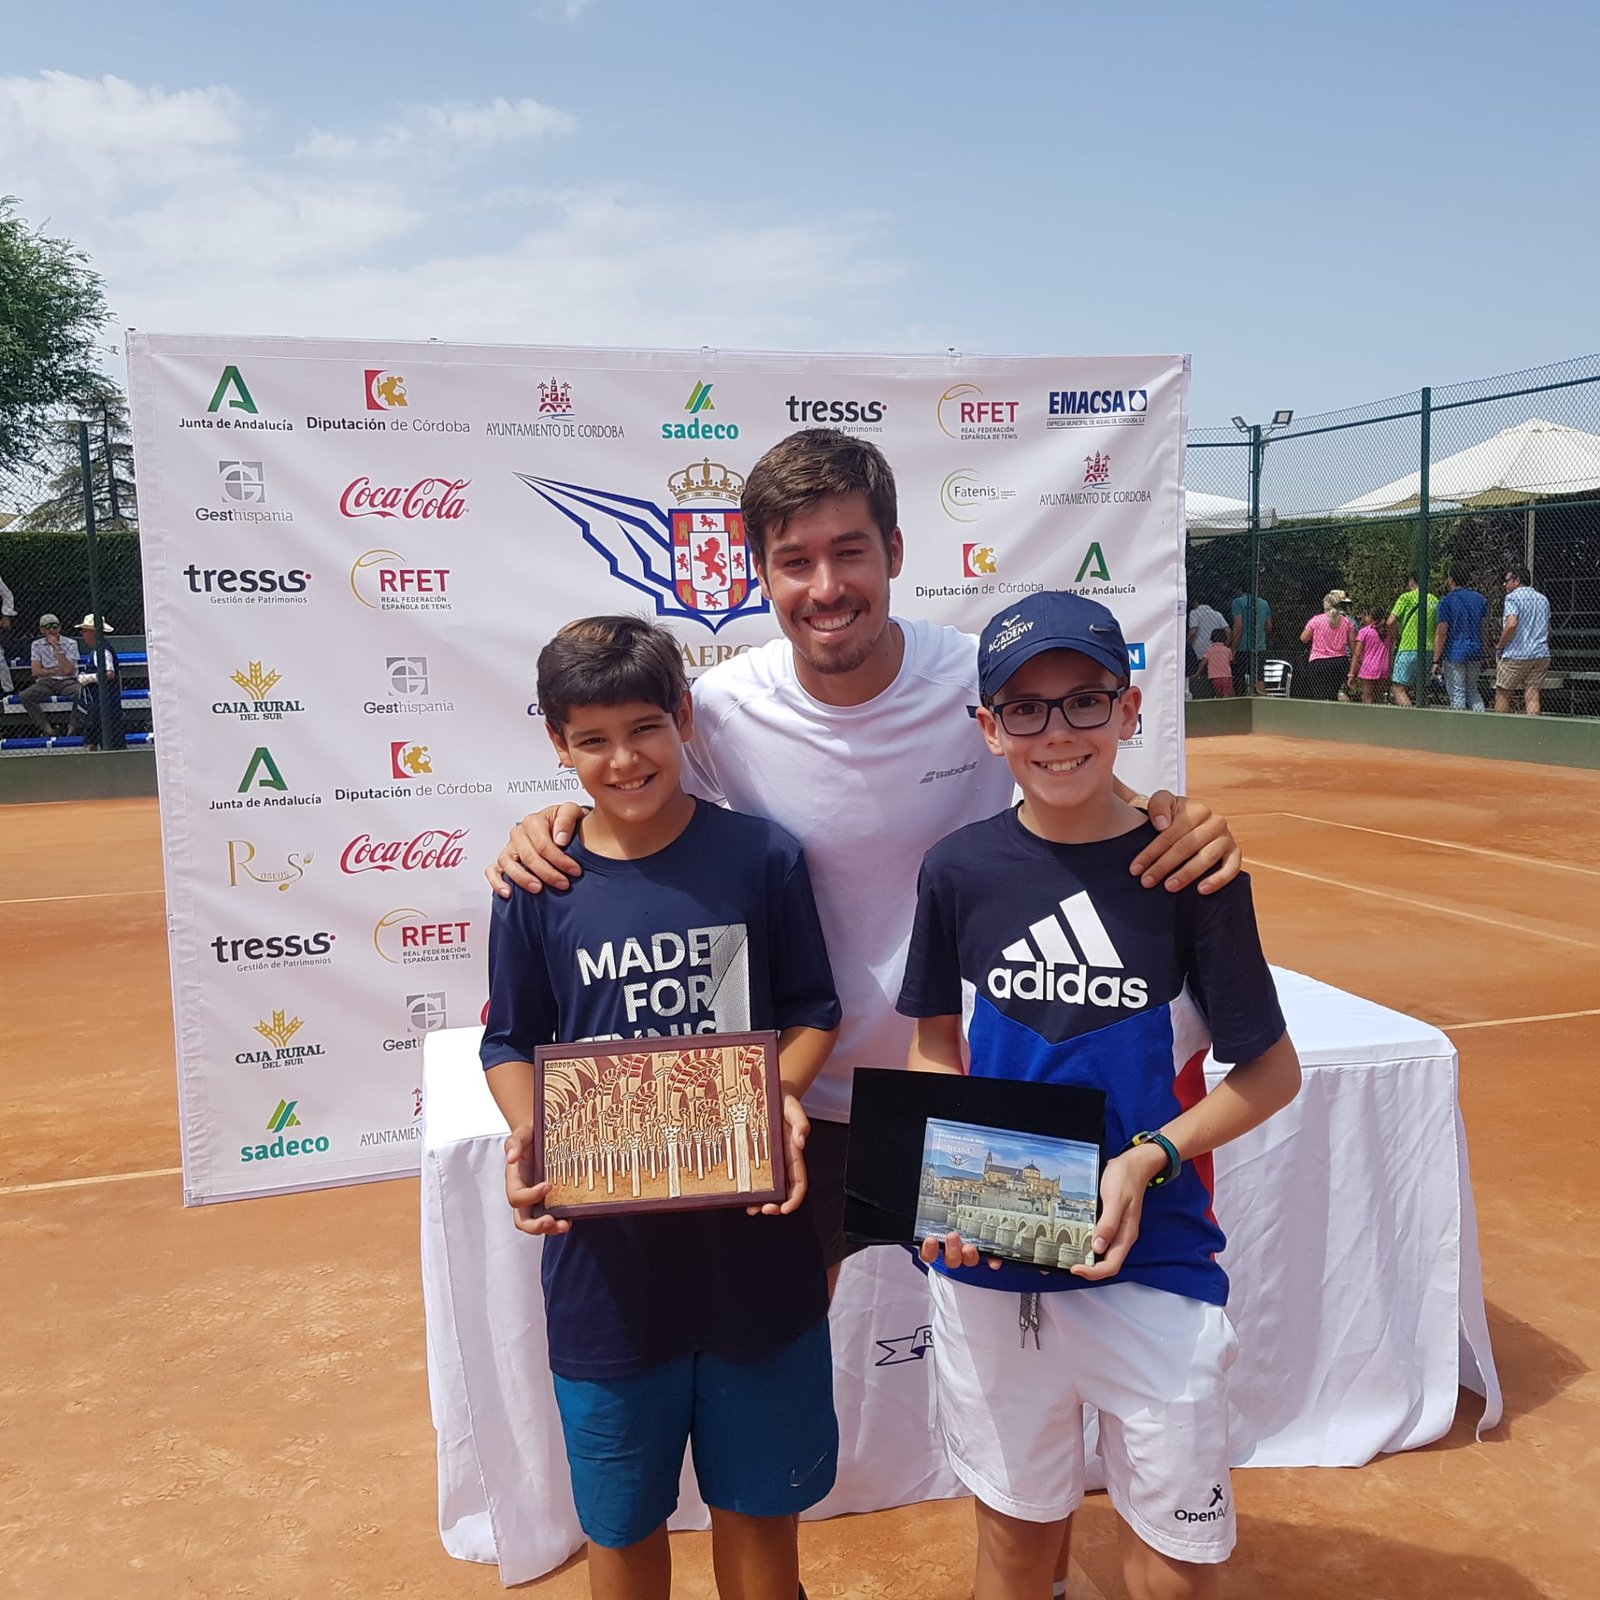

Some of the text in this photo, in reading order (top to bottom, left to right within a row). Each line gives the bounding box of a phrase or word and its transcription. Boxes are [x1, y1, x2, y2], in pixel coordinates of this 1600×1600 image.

[785, 395, 888, 423] tressis
[1049, 390, 1126, 414] EMACSA
[961, 402, 1019, 423] RFET
[178, 418, 294, 431] Junta de Andalucía
[306, 416, 471, 433] Diputación de Córdoba
[486, 422, 625, 439] AYUNTAMIENTO DE CORDOBA
[661, 418, 739, 440] sadeco
[339, 477, 472, 520] Coca-Cola
[954, 485, 996, 498] Fatenis
[1039, 490, 1152, 506] AYUNTAMIENTO DE CORDOBA
[195, 507, 294, 524] Gesthispania
[183, 564, 312, 593] tressis
[379, 569, 450, 592] RFET
[915, 583, 979, 597] Diputación
[981, 583, 995, 595] de
[998, 581, 1044, 595] Córdoba
[1079, 587, 1091, 596] de
[1092, 583, 1136, 595] Andalucía
[210, 594, 308, 605] Gestión de Patrimonios
[402, 595, 447, 603] FEDERACIÓN
[988, 621, 1034, 654] ACADEMY
[211, 700, 305, 714] CAJA RURAL
[363, 700, 455, 716] Gesthispania
[239, 712, 283, 721] DEL SUR
[335, 781, 493, 802] Diputación de Córdoba
[507, 778, 579, 794] AYUNTAMIENTO
[209, 793, 322, 810] Junta de Andalucía
[340, 828, 470, 874] Coca-Cola
[402, 922, 470, 947] RFET
[211, 932, 336, 964] tressis
[422, 946, 467, 955] FEDERACIÓN
[577, 926, 713, 986] MADE
[237, 957, 332, 973] Gestión de Patrimonios
[403, 955, 440, 964] ESPAÑOLA
[987, 961, 1148, 1009] adidas
[624, 974, 715, 1023] FOR
[235, 1044, 325, 1065] CAJA RURAL
[262, 1058, 304, 1069] DEL SUR
[360, 1127, 422, 1147] AYUNTAMIEN
[240, 1135, 329, 1162] sadeco
[1174, 1507, 1227, 1523] OpenA
